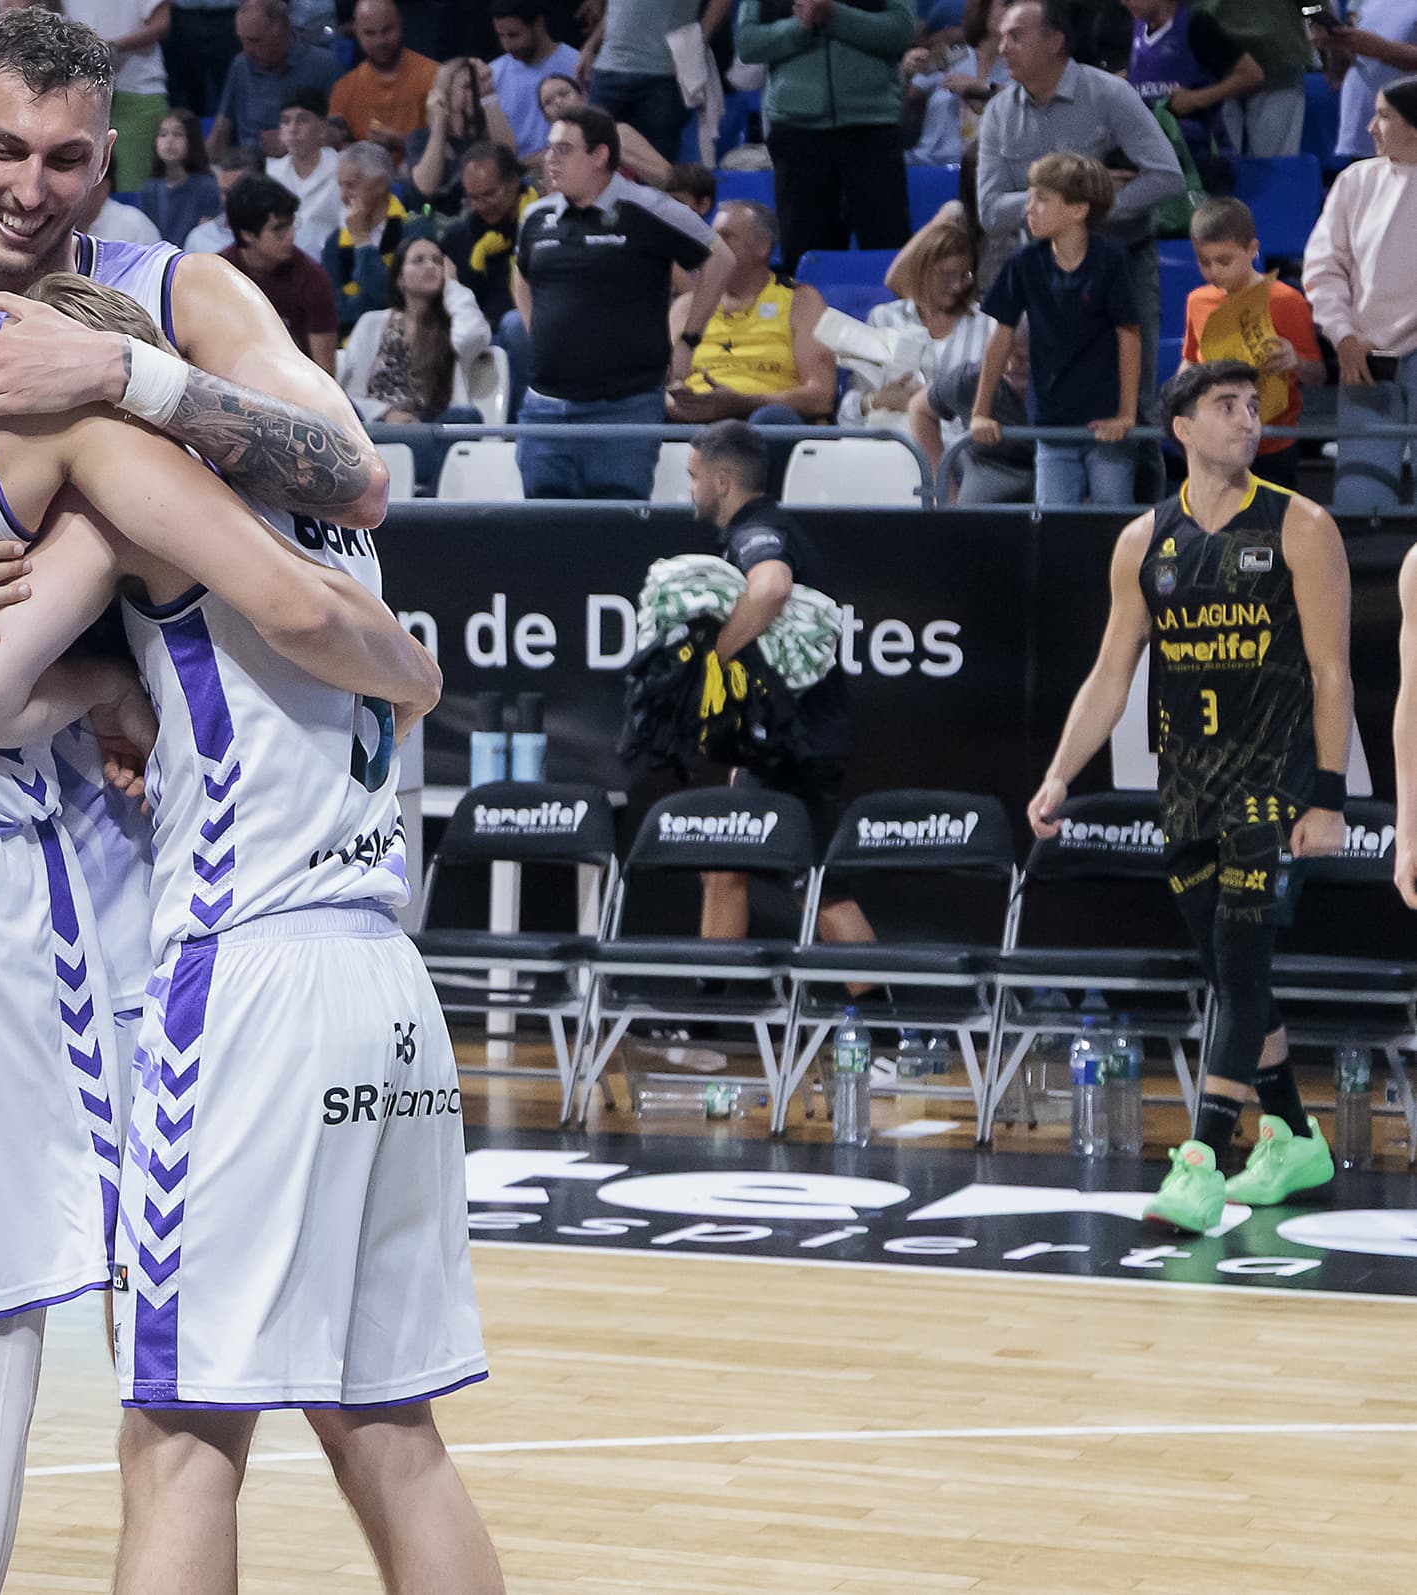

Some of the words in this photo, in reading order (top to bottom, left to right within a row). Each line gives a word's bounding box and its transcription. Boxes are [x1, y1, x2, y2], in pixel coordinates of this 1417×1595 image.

[464, 592, 558, 669] de
[1181, 603, 1272, 629] LAGUNA
[1200, 689, 1218, 735] 3
[323, 1084, 378, 1125] SR
[467, 1208, 1324, 1277] espierta
